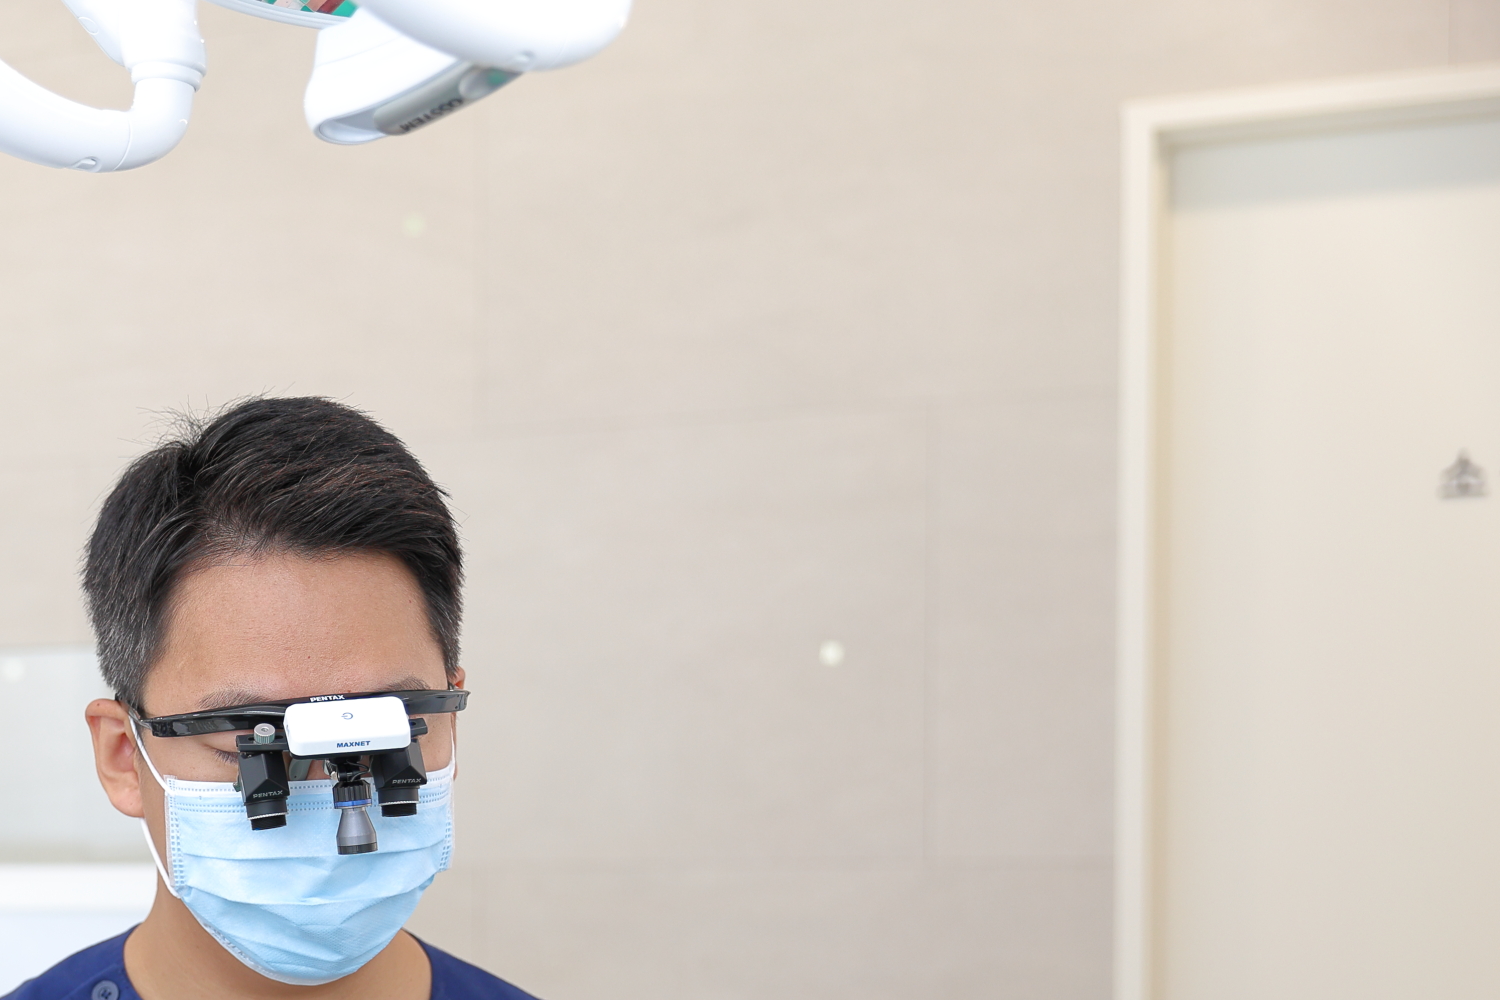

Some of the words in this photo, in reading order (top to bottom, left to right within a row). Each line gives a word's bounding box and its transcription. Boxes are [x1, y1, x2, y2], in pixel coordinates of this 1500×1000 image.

[309, 694, 345, 702] PENTAX
[336, 740, 371, 748] MAXNET
[252, 790, 283, 799] PENTAX
